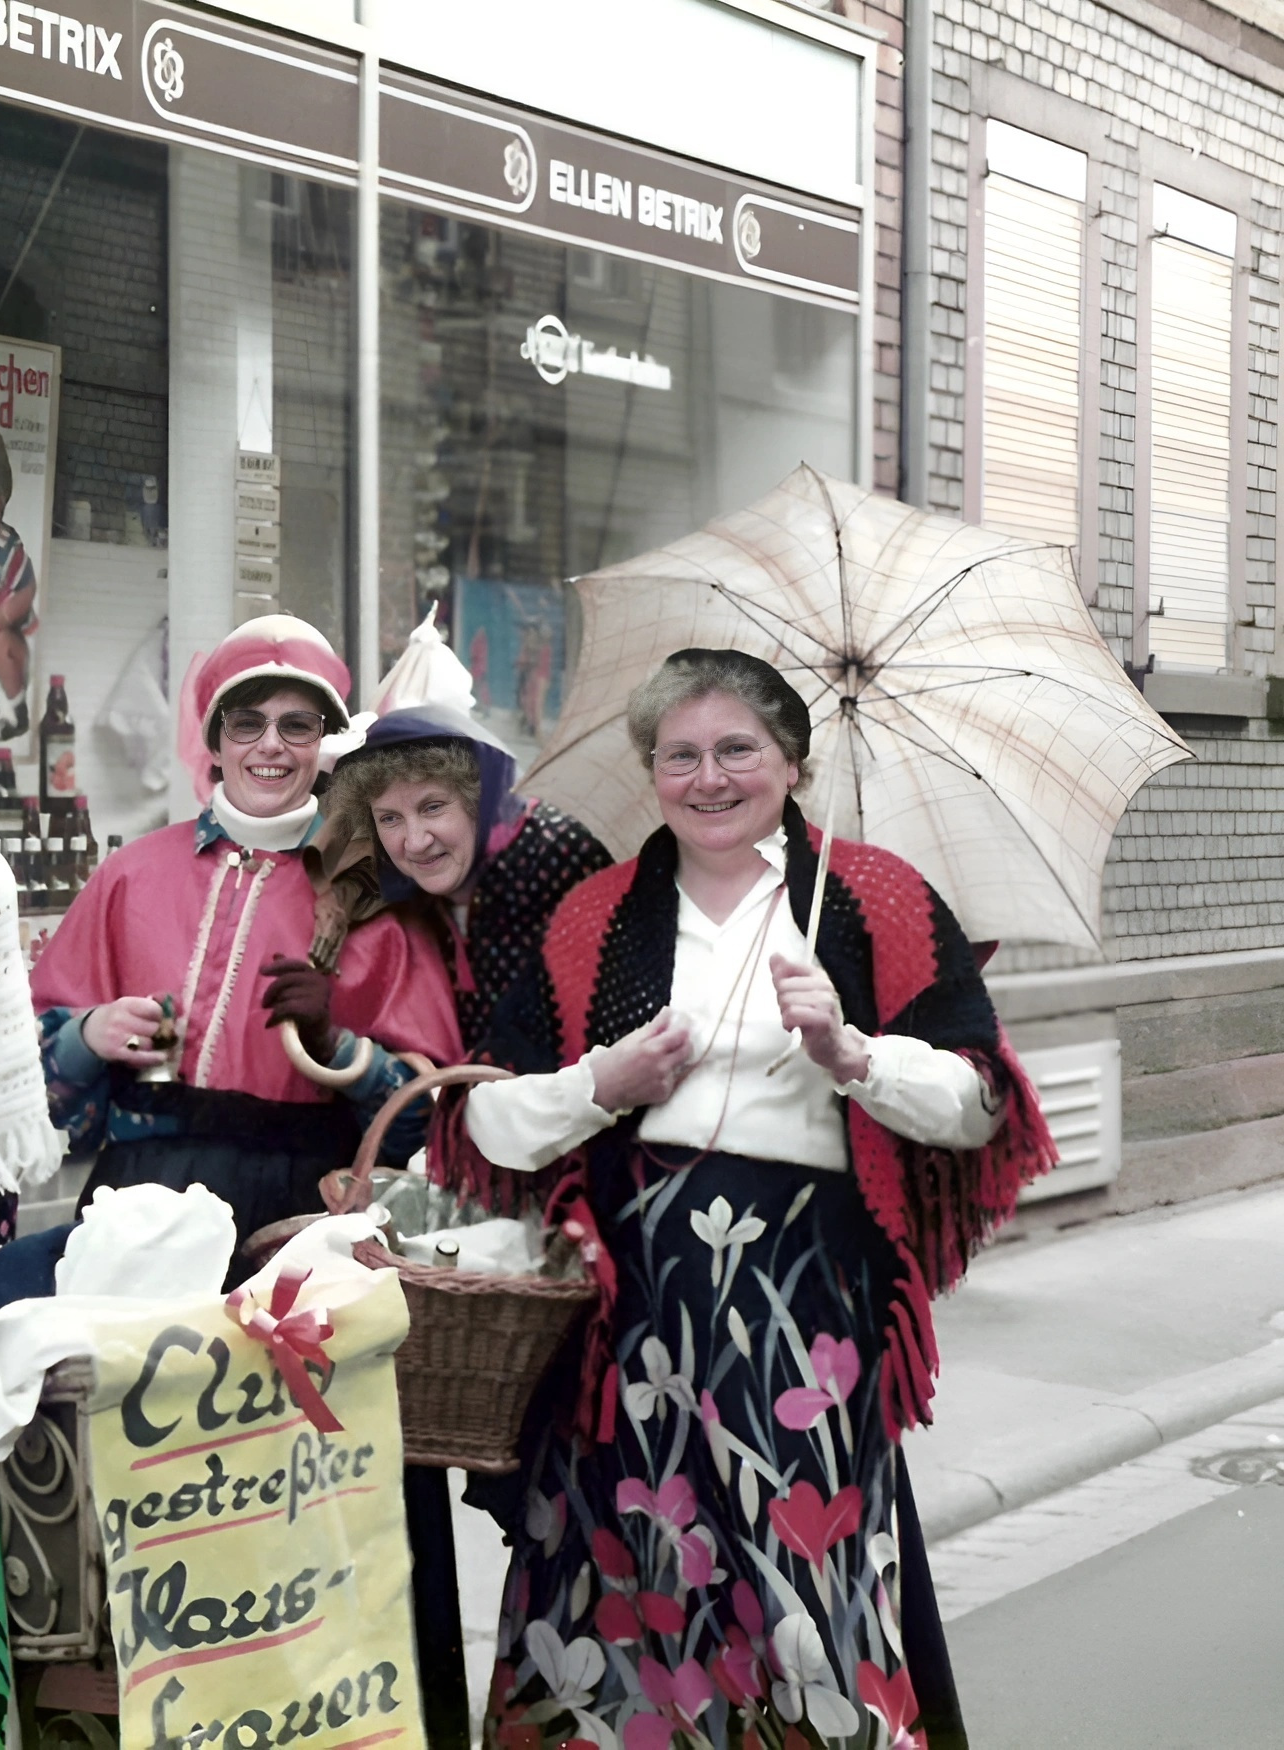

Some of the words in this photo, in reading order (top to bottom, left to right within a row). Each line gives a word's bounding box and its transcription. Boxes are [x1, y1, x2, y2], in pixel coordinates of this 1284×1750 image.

[549, 159, 632, 219] ELLEN
[638, 184, 724, 245] BETRIX
[103, 1431, 375, 1562] gestreßter
